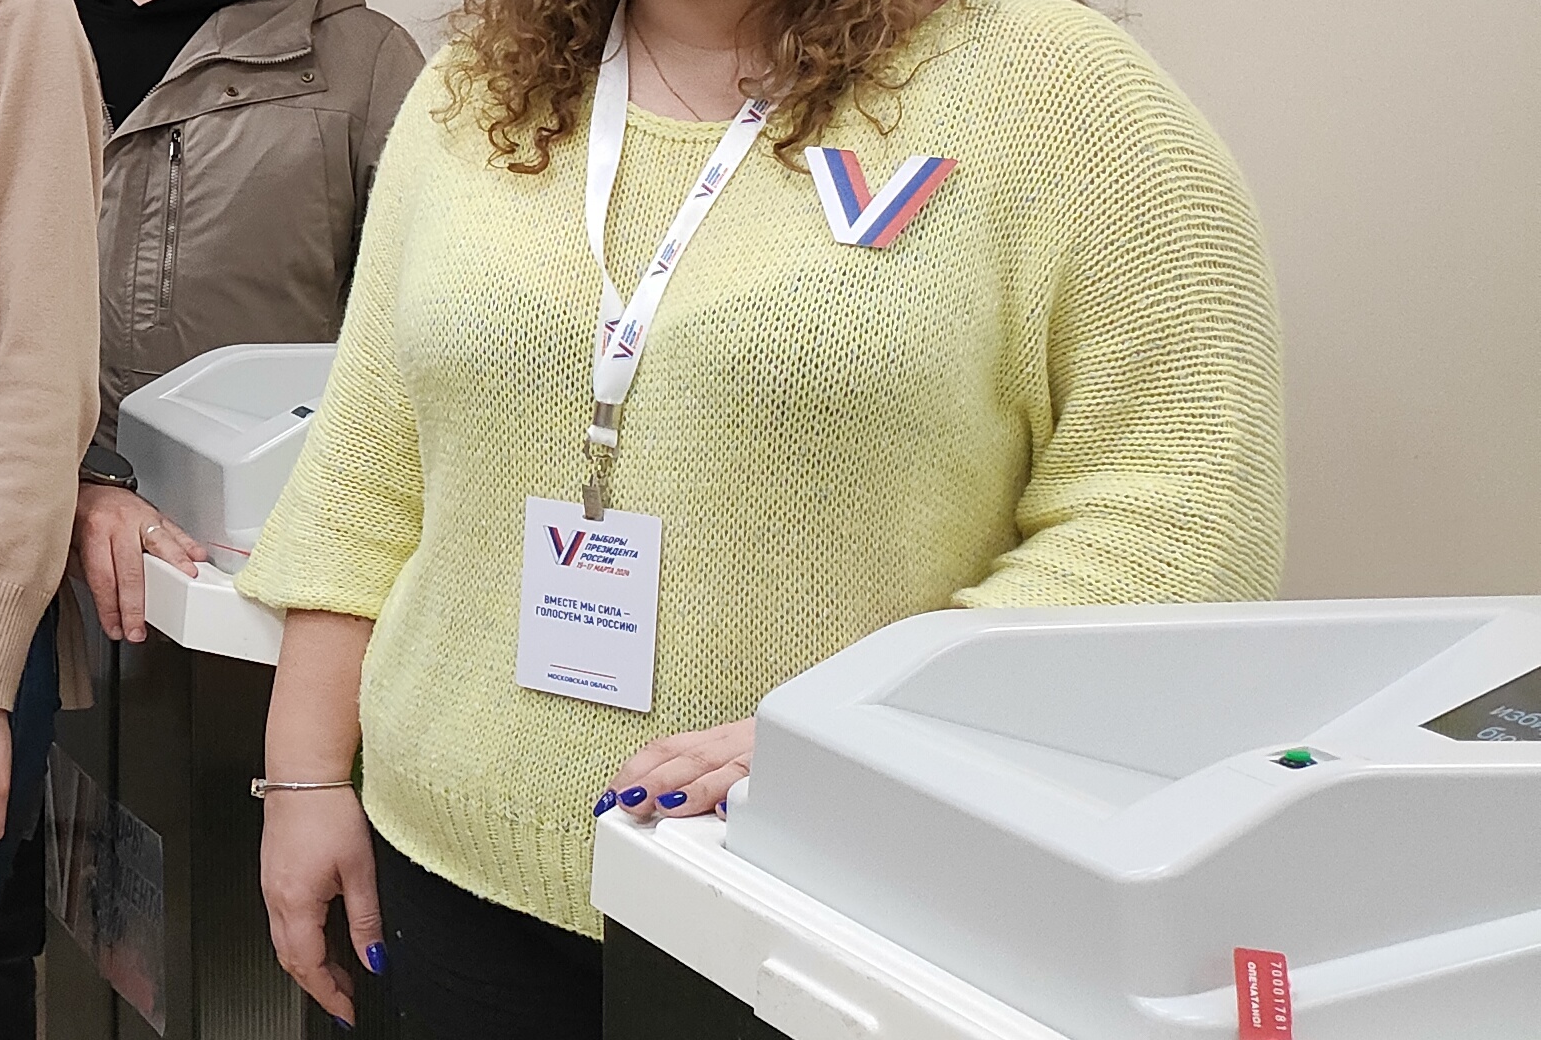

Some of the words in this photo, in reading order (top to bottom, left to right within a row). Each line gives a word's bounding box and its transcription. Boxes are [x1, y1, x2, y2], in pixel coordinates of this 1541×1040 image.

[589, 533, 629, 547] ВЫБОРЫ
[579, 552, 616, 565] РОССИИ
[585, 542, 639, 559] ПРЕЗИДЕНТА
[593, 564, 615, 575] МАРТА
[544, 594, 578, 610] ВМЕСТЕ
[580, 600, 596, 612] МЫ
[597, 604, 622, 618] СИЛА
[535, 605, 582, 623] ГОЛОСУЕМ
[583, 614, 595, 625] ЗА
[596, 617, 638, 634] РОССИЮ!
[547, 672, 589, 686] МОСКОВСКАЯ
[589, 680, 618, 692] ОБЛАСТЬ
[1270, 961, 1287, 1031] 70001781
